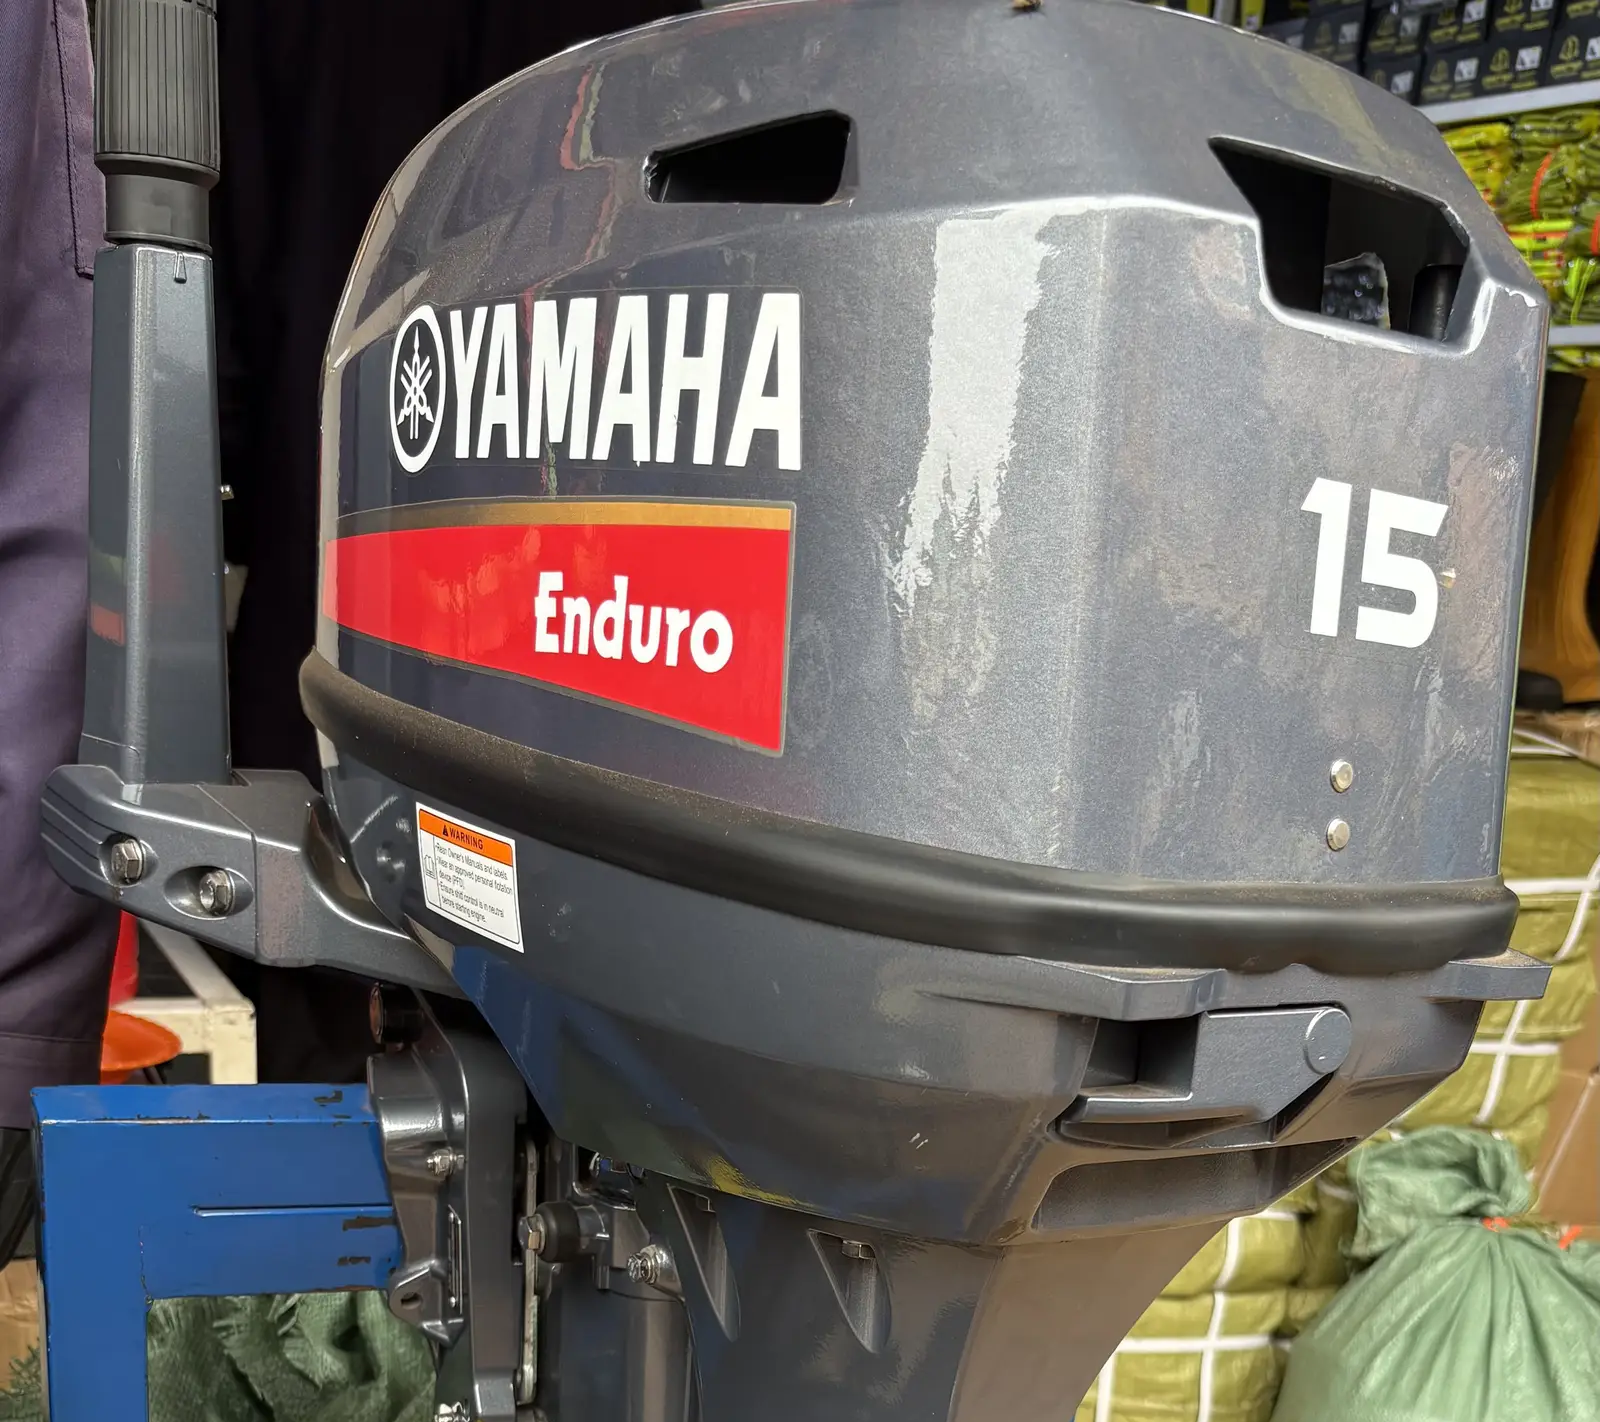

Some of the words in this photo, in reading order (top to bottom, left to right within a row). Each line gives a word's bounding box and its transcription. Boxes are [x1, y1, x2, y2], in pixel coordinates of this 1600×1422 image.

[450, 293, 800, 471] YAMAHA
[534, 571, 734, 673] Enduro
[1301, 476, 1449, 648] 15
[449, 827, 483, 849] WARNING
